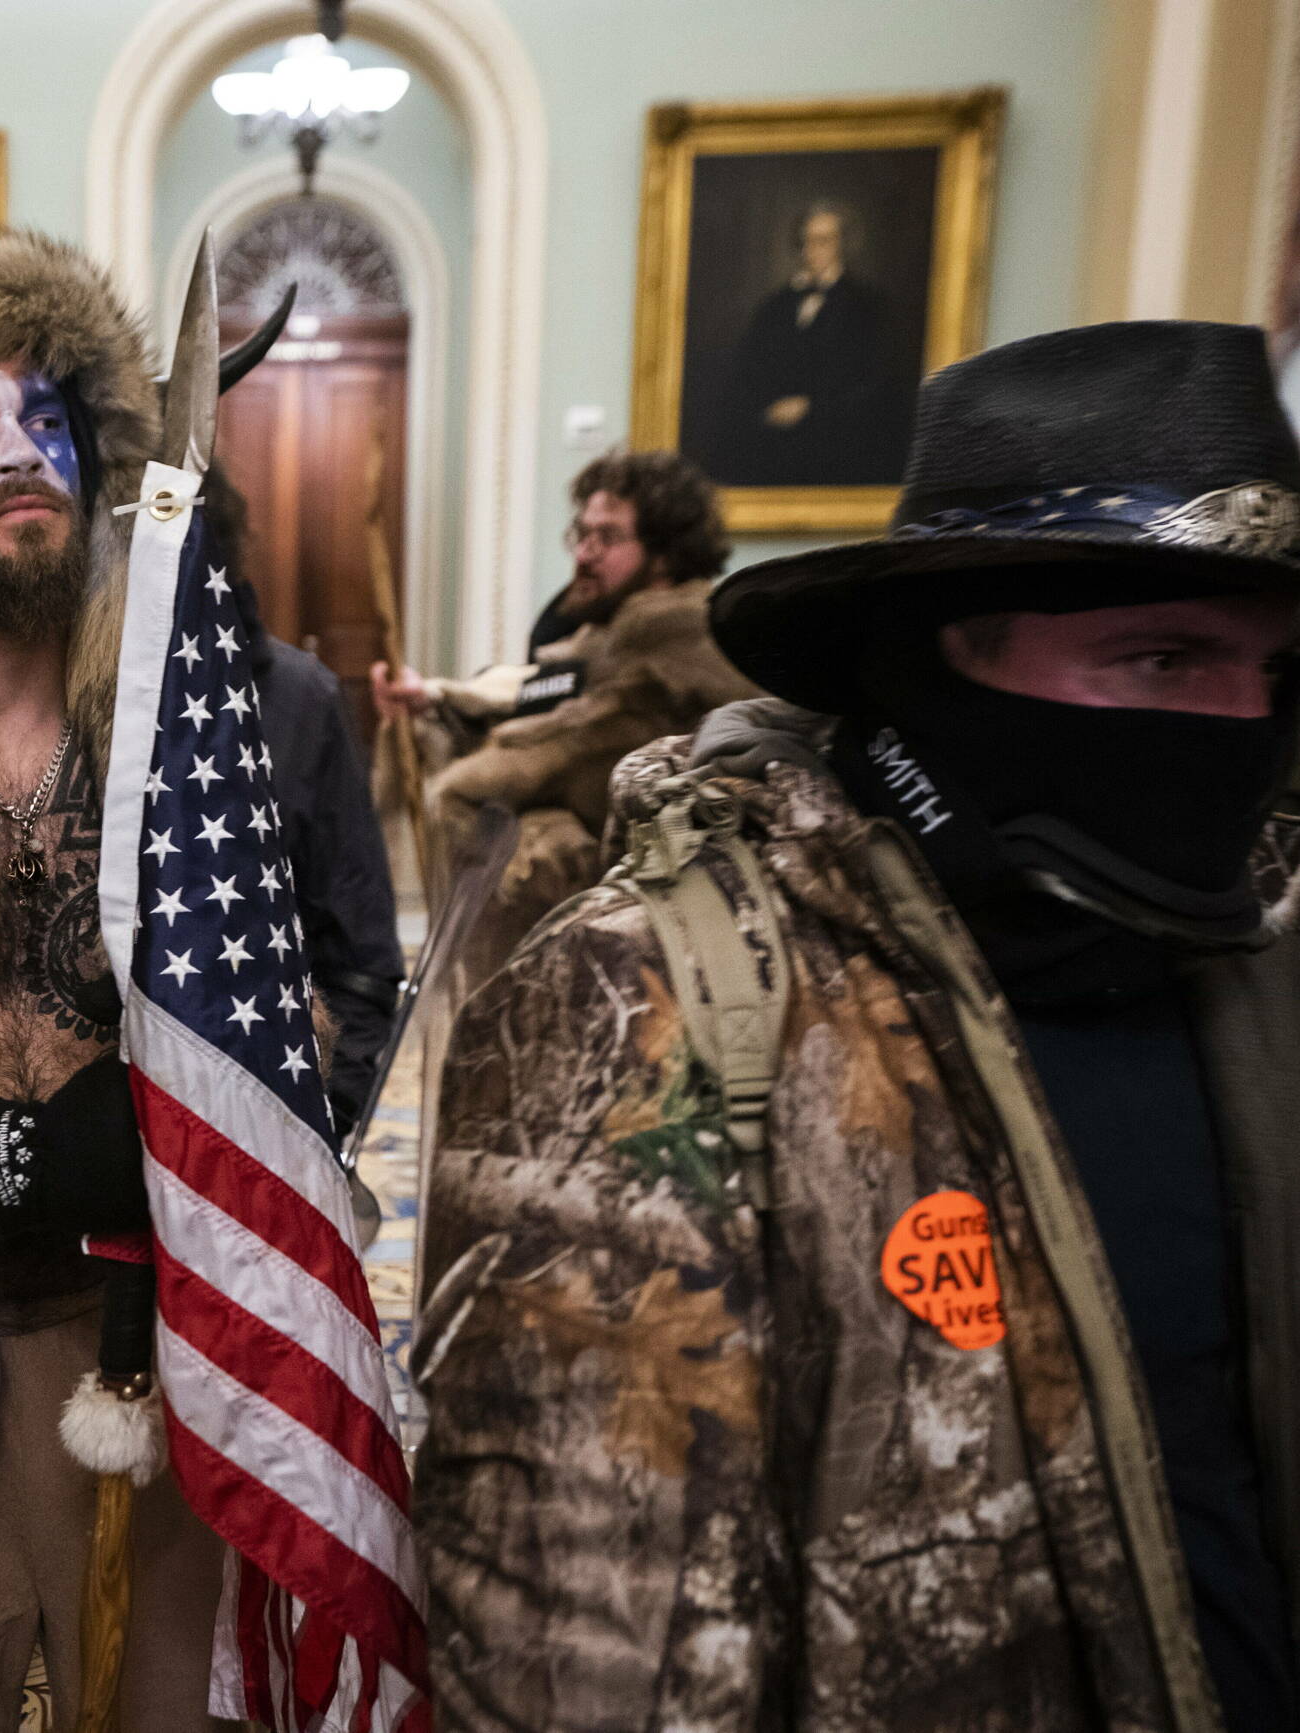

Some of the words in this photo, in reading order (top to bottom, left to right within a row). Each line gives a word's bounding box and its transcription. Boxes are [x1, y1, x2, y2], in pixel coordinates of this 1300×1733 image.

[868, 727, 953, 834] SMITH
[1, 1166, 20, 1206] SOCIETY
[897, 1247, 986, 1294] SAV
